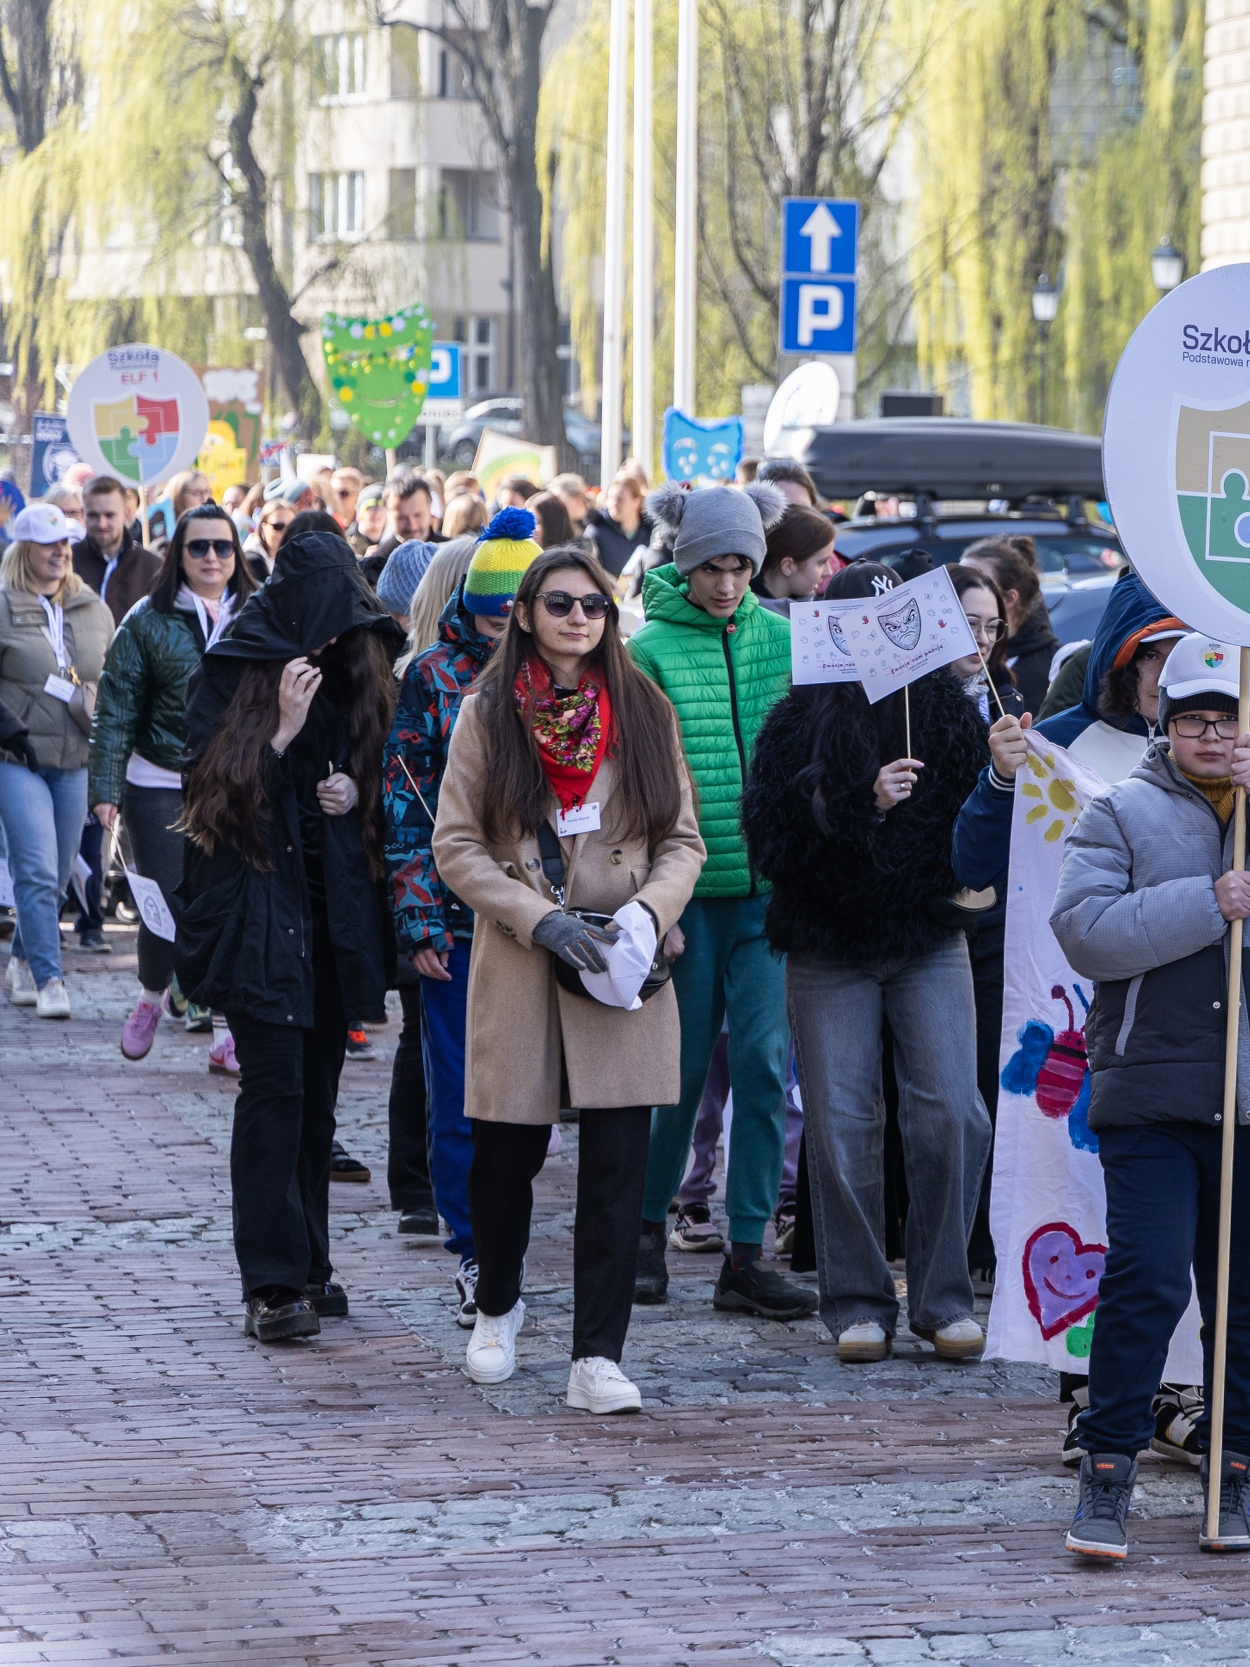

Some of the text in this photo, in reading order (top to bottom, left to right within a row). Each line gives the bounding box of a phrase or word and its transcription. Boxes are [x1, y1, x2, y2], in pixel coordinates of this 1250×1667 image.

[798, 286, 844, 346] P
[1182, 351, 1244, 367] Podstawowa
[121, 370, 147, 385] ELF
[1095, 1462, 1115, 1470] adidas
[1230, 1461, 1247, 1471] adidas
